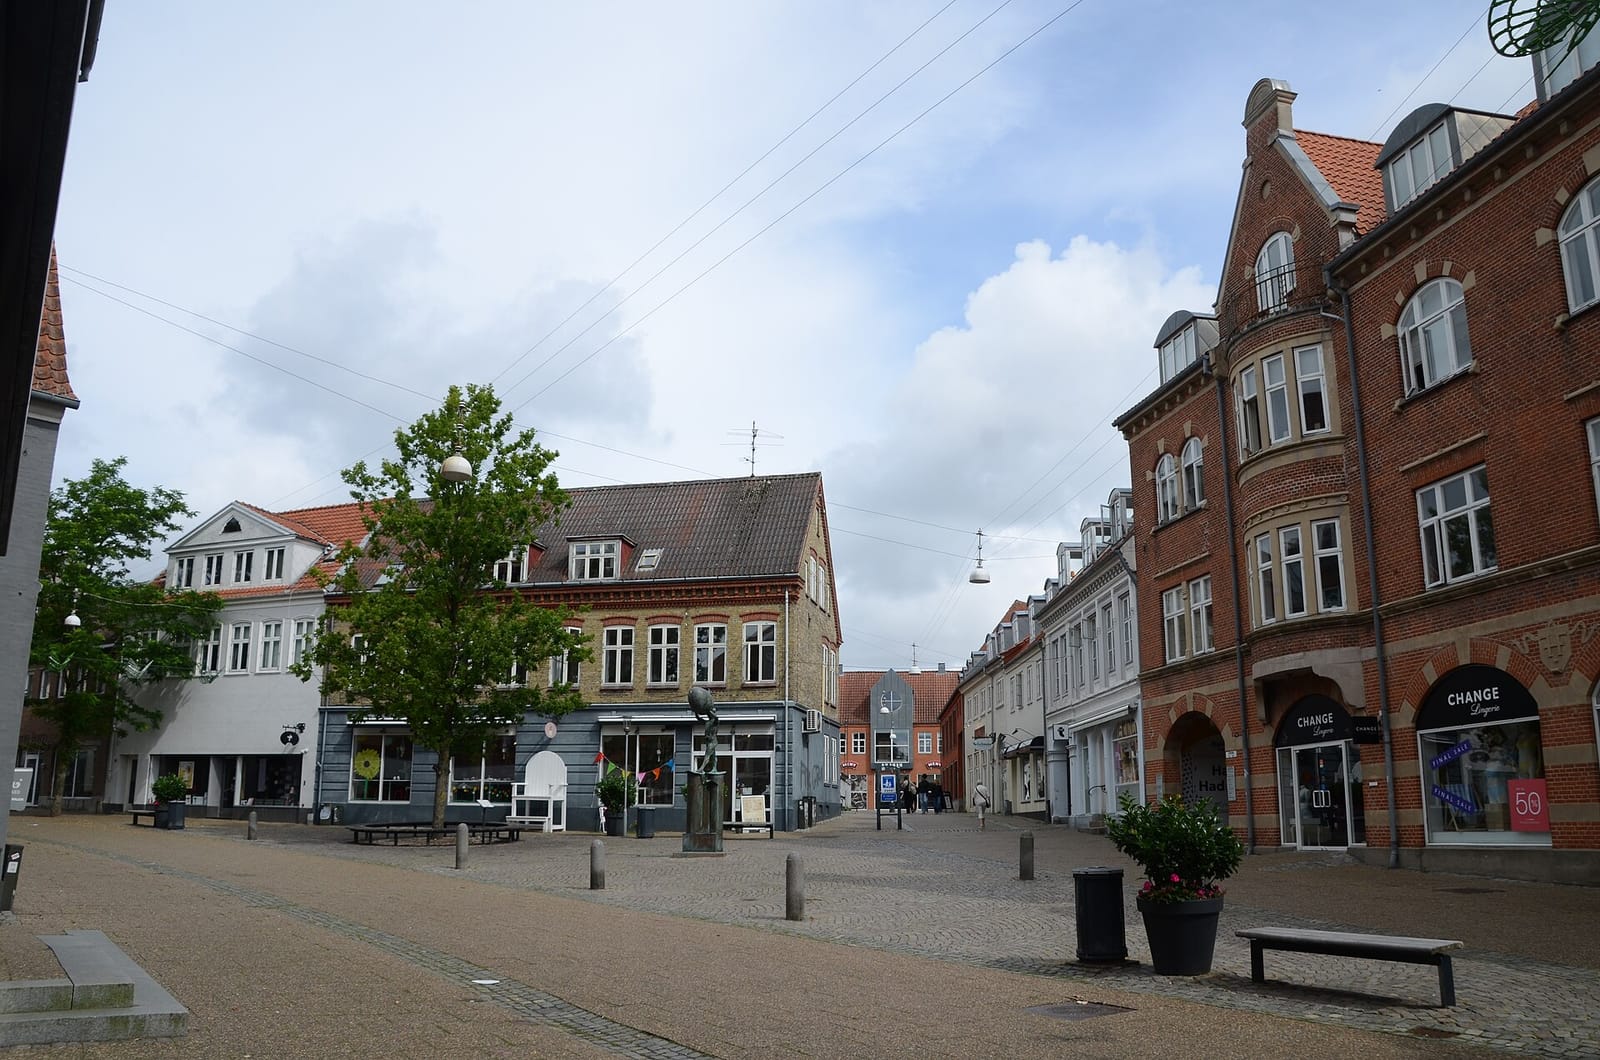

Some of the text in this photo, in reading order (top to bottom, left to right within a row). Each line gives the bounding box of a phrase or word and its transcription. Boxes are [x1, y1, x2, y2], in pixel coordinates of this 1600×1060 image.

[1447, 686, 1500, 706] CHANGE
[1470, 703, 1501, 718] Lingerie
[1297, 712, 1334, 728] CHANGE
[1199, 780, 1225, 792] Had
